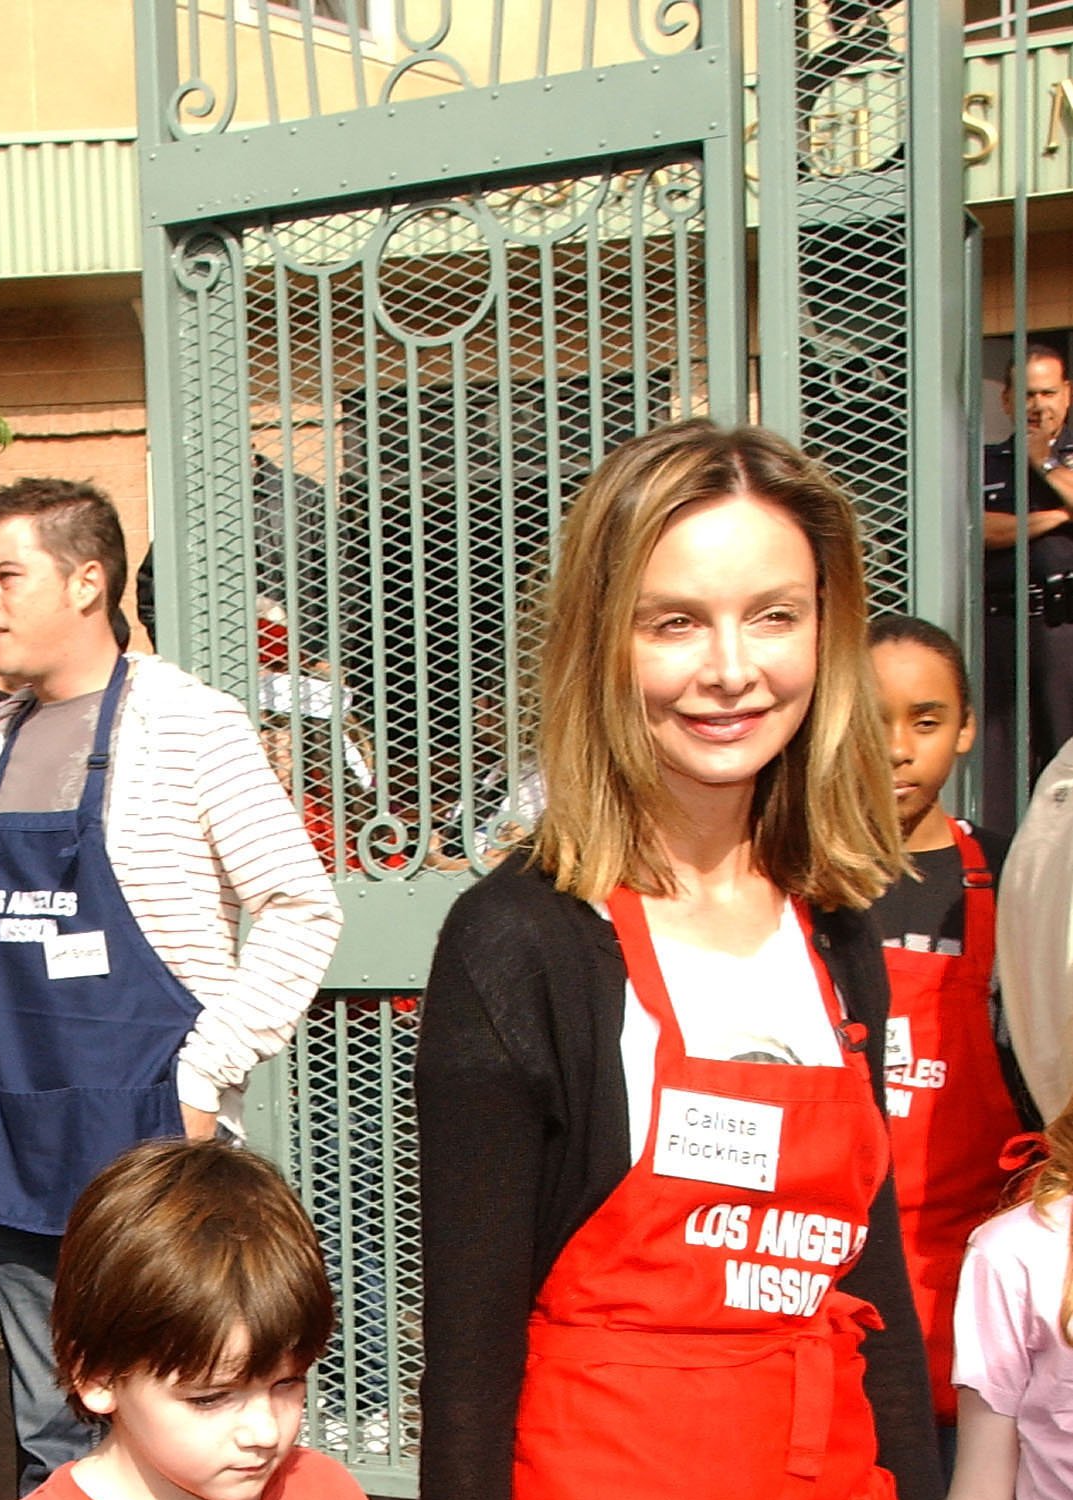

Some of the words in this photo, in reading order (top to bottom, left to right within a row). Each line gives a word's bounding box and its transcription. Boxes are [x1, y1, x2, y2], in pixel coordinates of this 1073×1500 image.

[884, 1058, 948, 1088] ELES
[685, 1107, 758, 1136] Calista
[667, 1134, 768, 1168] Flockhart
[684, 1203, 753, 1250] LOS
[756, 1208, 869, 1266] ANGEL
[724, 1260, 835, 1318] MISSIO
